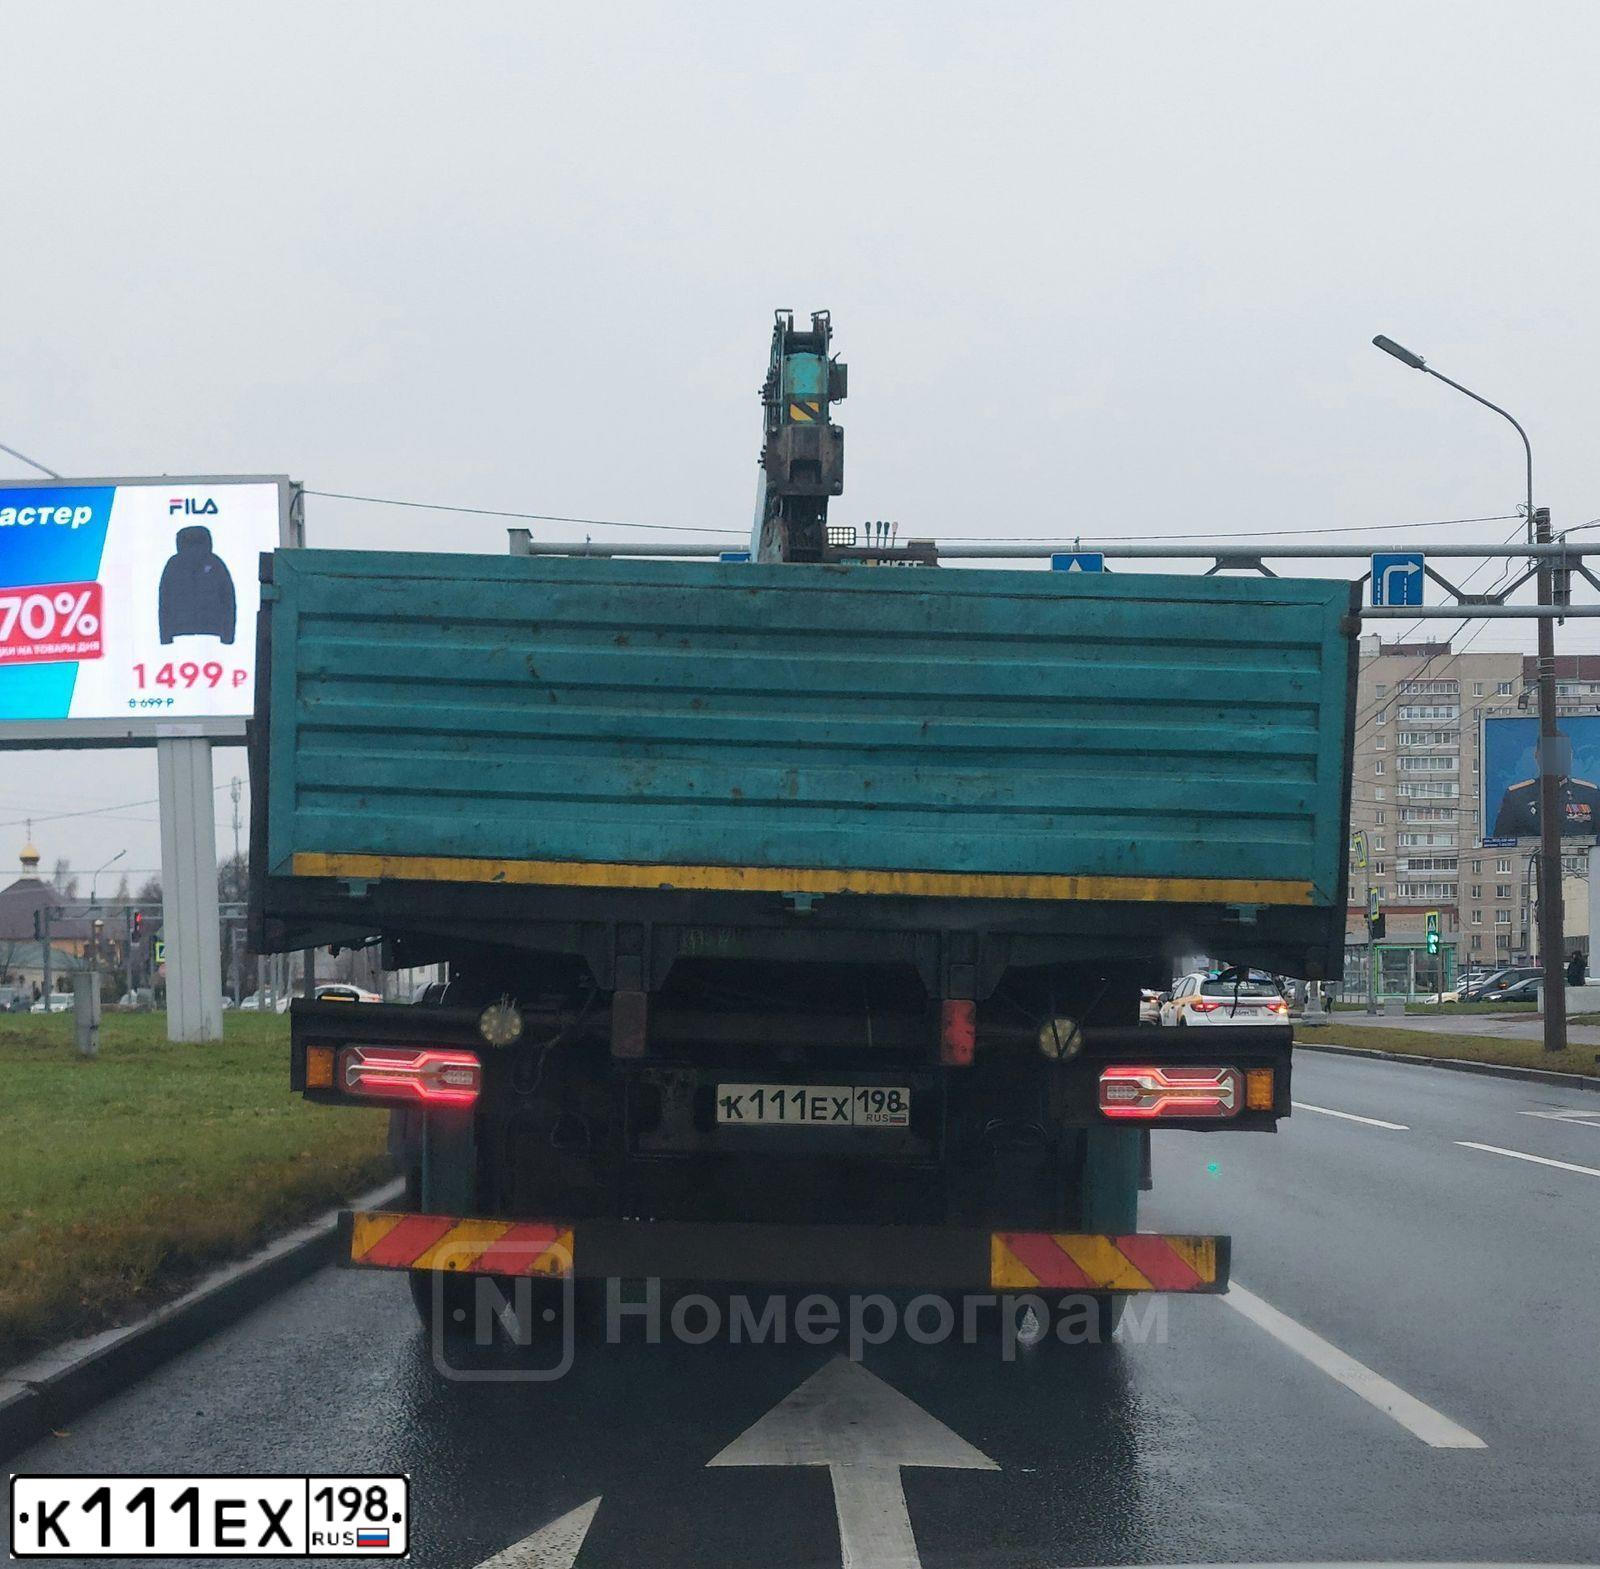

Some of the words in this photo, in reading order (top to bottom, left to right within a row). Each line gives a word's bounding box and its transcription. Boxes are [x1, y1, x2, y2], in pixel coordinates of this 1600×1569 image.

[0, 506, 92, 529] астер
[169, 498, 218, 515] FILA
[0, 591, 99, 641] 70%
[857, 1089, 901, 1113] 198
[866, 1113, 889, 1123] RUS
